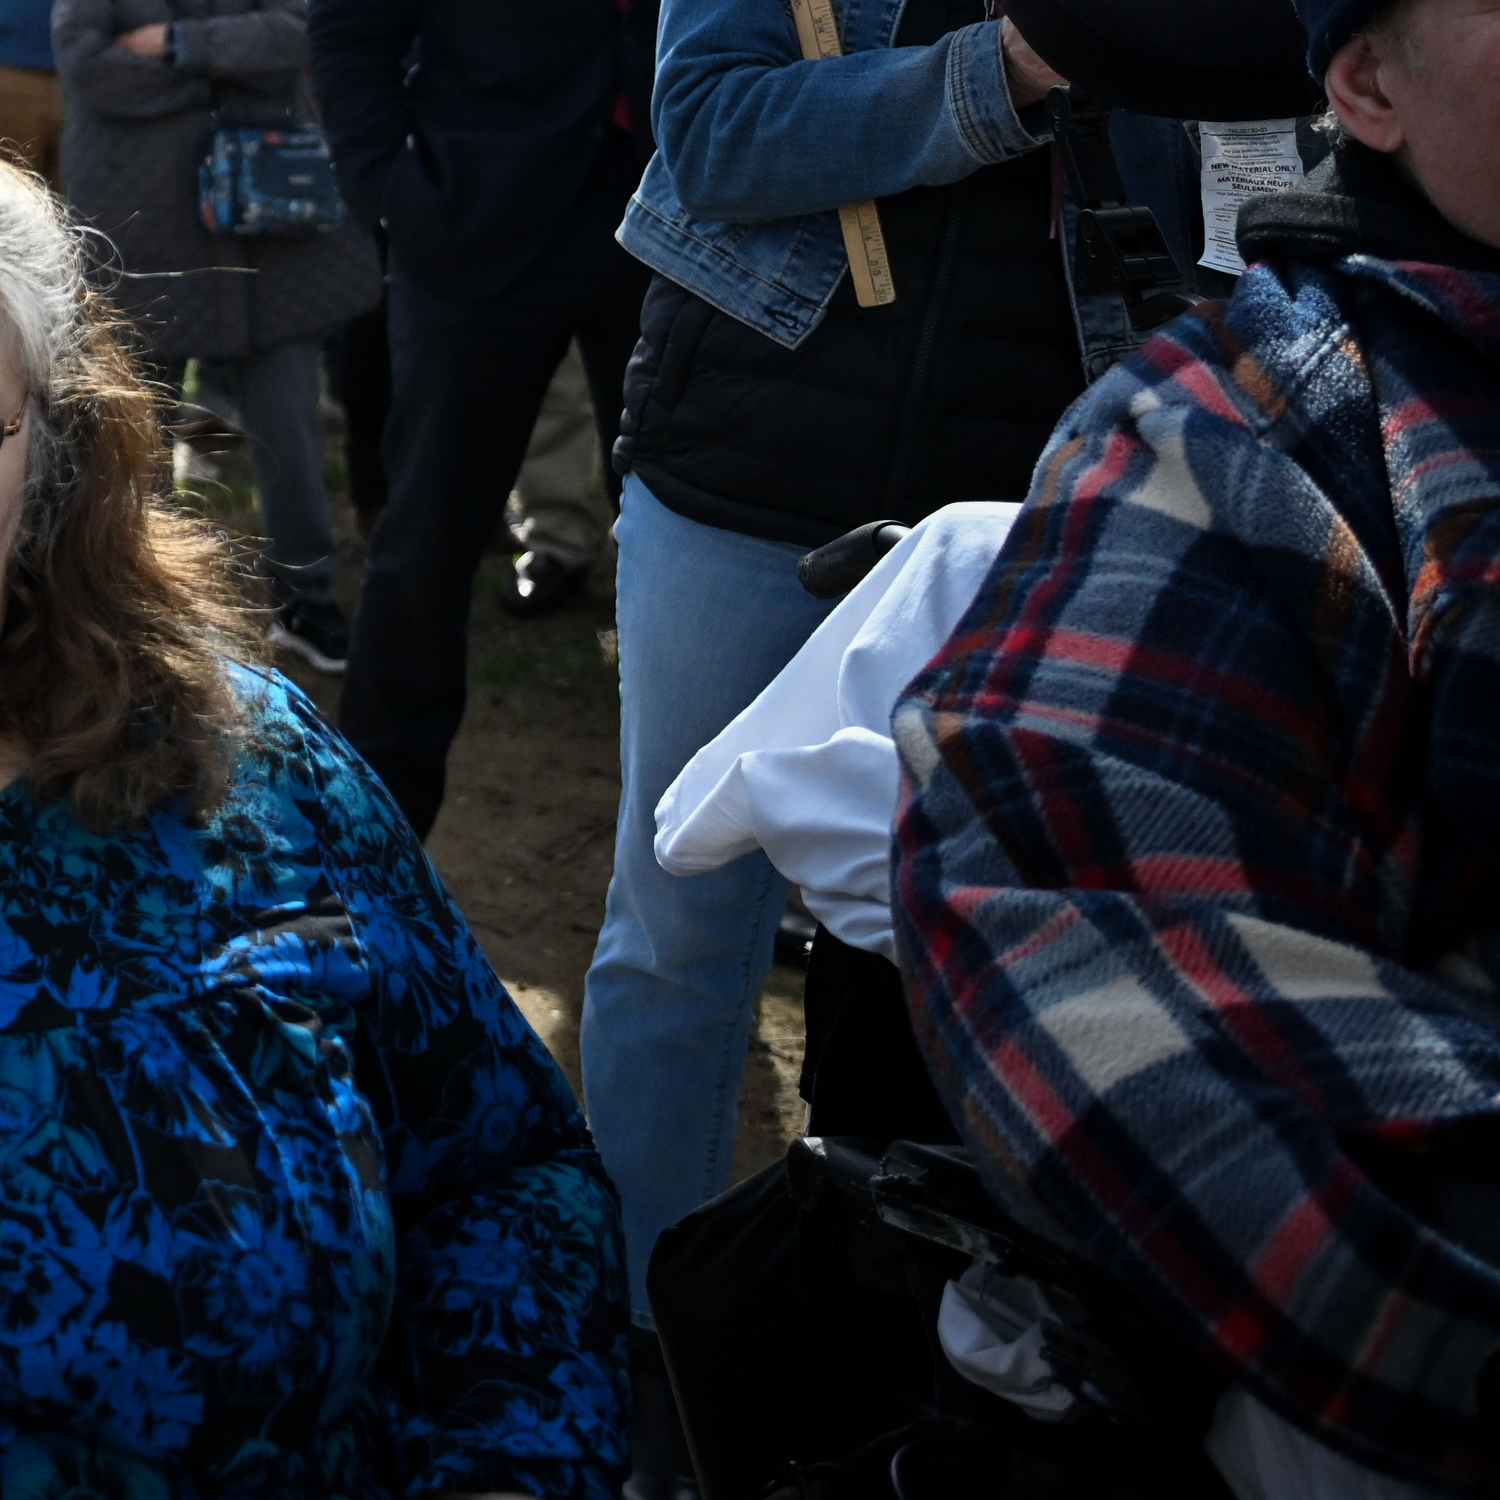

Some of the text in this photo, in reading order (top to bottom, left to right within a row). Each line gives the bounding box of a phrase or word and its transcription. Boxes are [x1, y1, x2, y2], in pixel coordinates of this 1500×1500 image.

[813, 16, 825, 33] 28
[1211, 163, 1230, 171] NEW
[1231, 165, 1272, 173] MATERIAL
[1231, 183, 1279, 193] SEULEMENT
